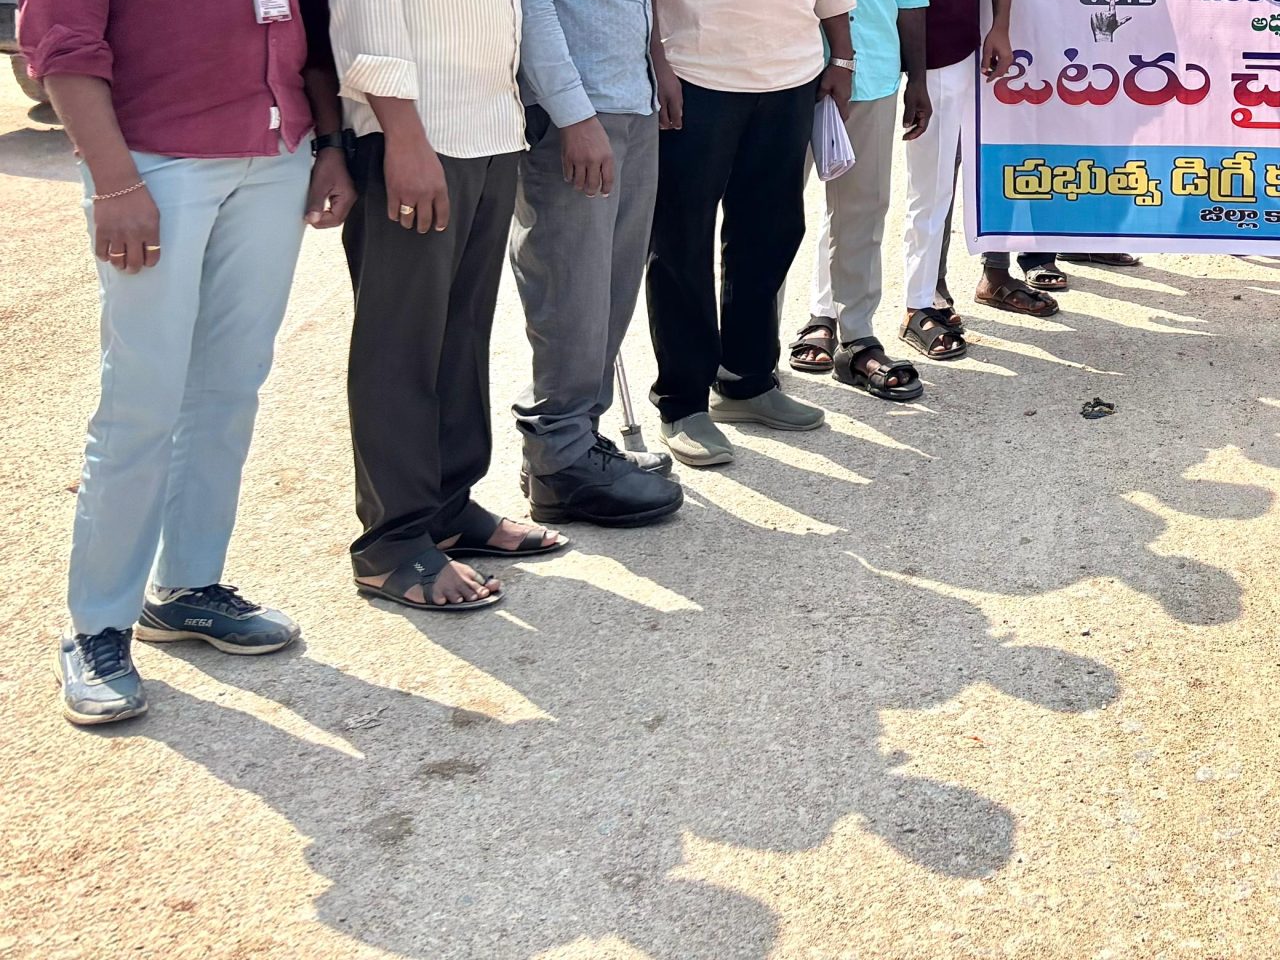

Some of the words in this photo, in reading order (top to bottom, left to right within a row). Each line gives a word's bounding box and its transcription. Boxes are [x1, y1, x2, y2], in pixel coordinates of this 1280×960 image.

[993, 48, 1211, 106] ఓటరు
[1003, 158, 1163, 207] ప్రభుత్వ
[1171, 151, 1257, 203] డిగ్రీ
[1200, 206, 1260, 229] జిల్లా
